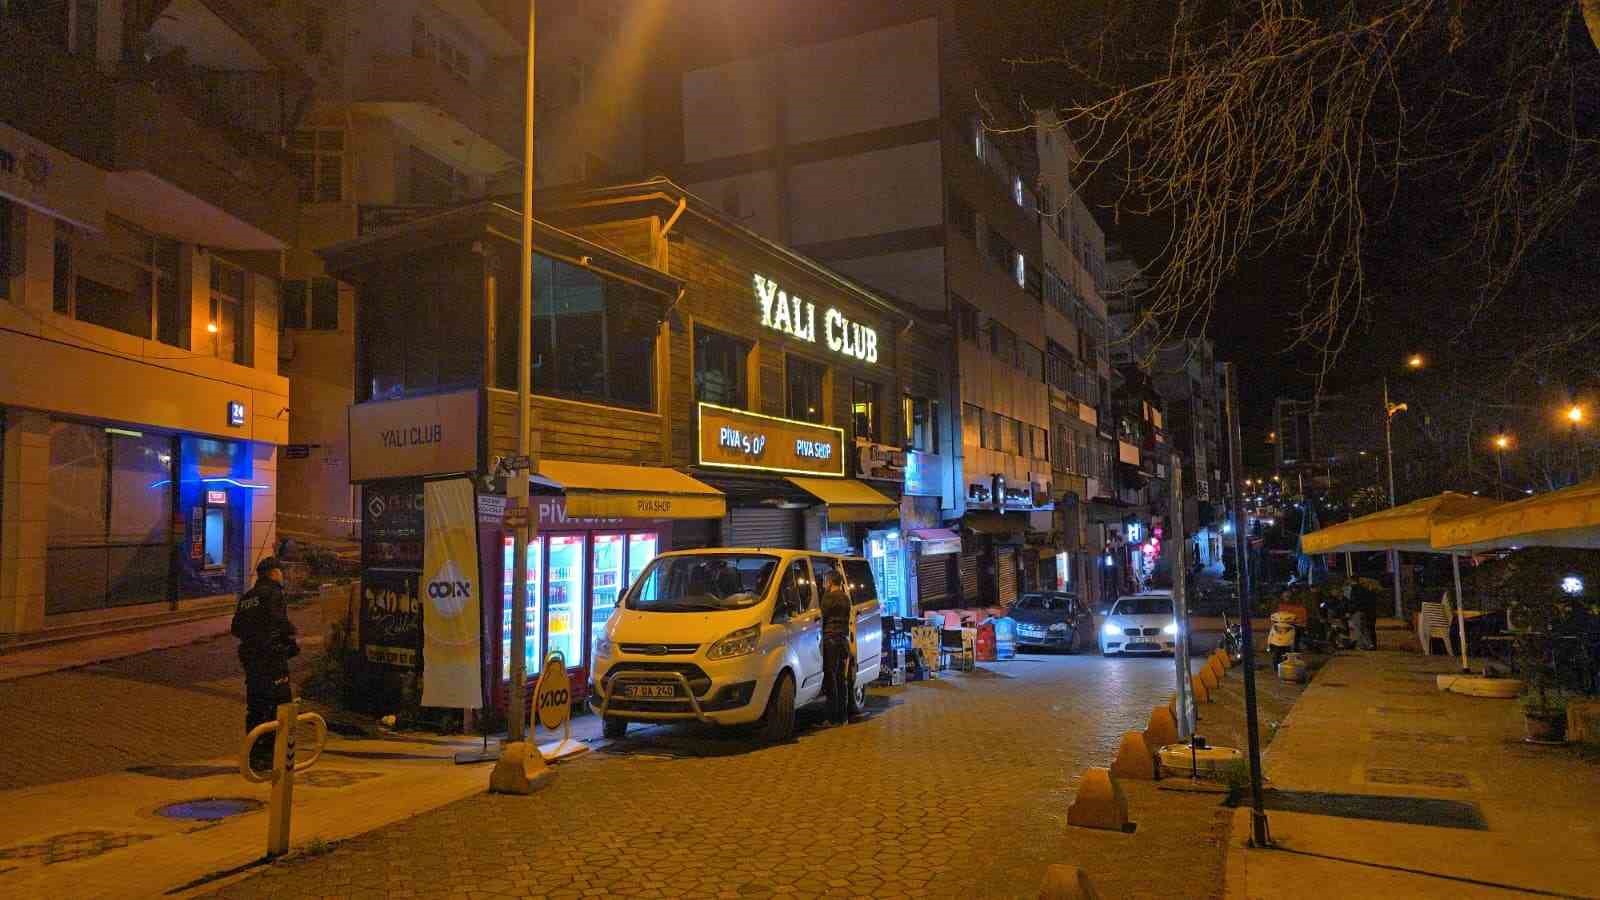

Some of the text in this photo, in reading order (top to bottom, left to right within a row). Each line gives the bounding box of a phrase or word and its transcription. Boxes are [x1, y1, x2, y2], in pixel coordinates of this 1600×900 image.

[753, 272, 878, 364] YALI CLUB
[409, 423, 441, 445] CLUB
[538, 498, 576, 524] PİV
